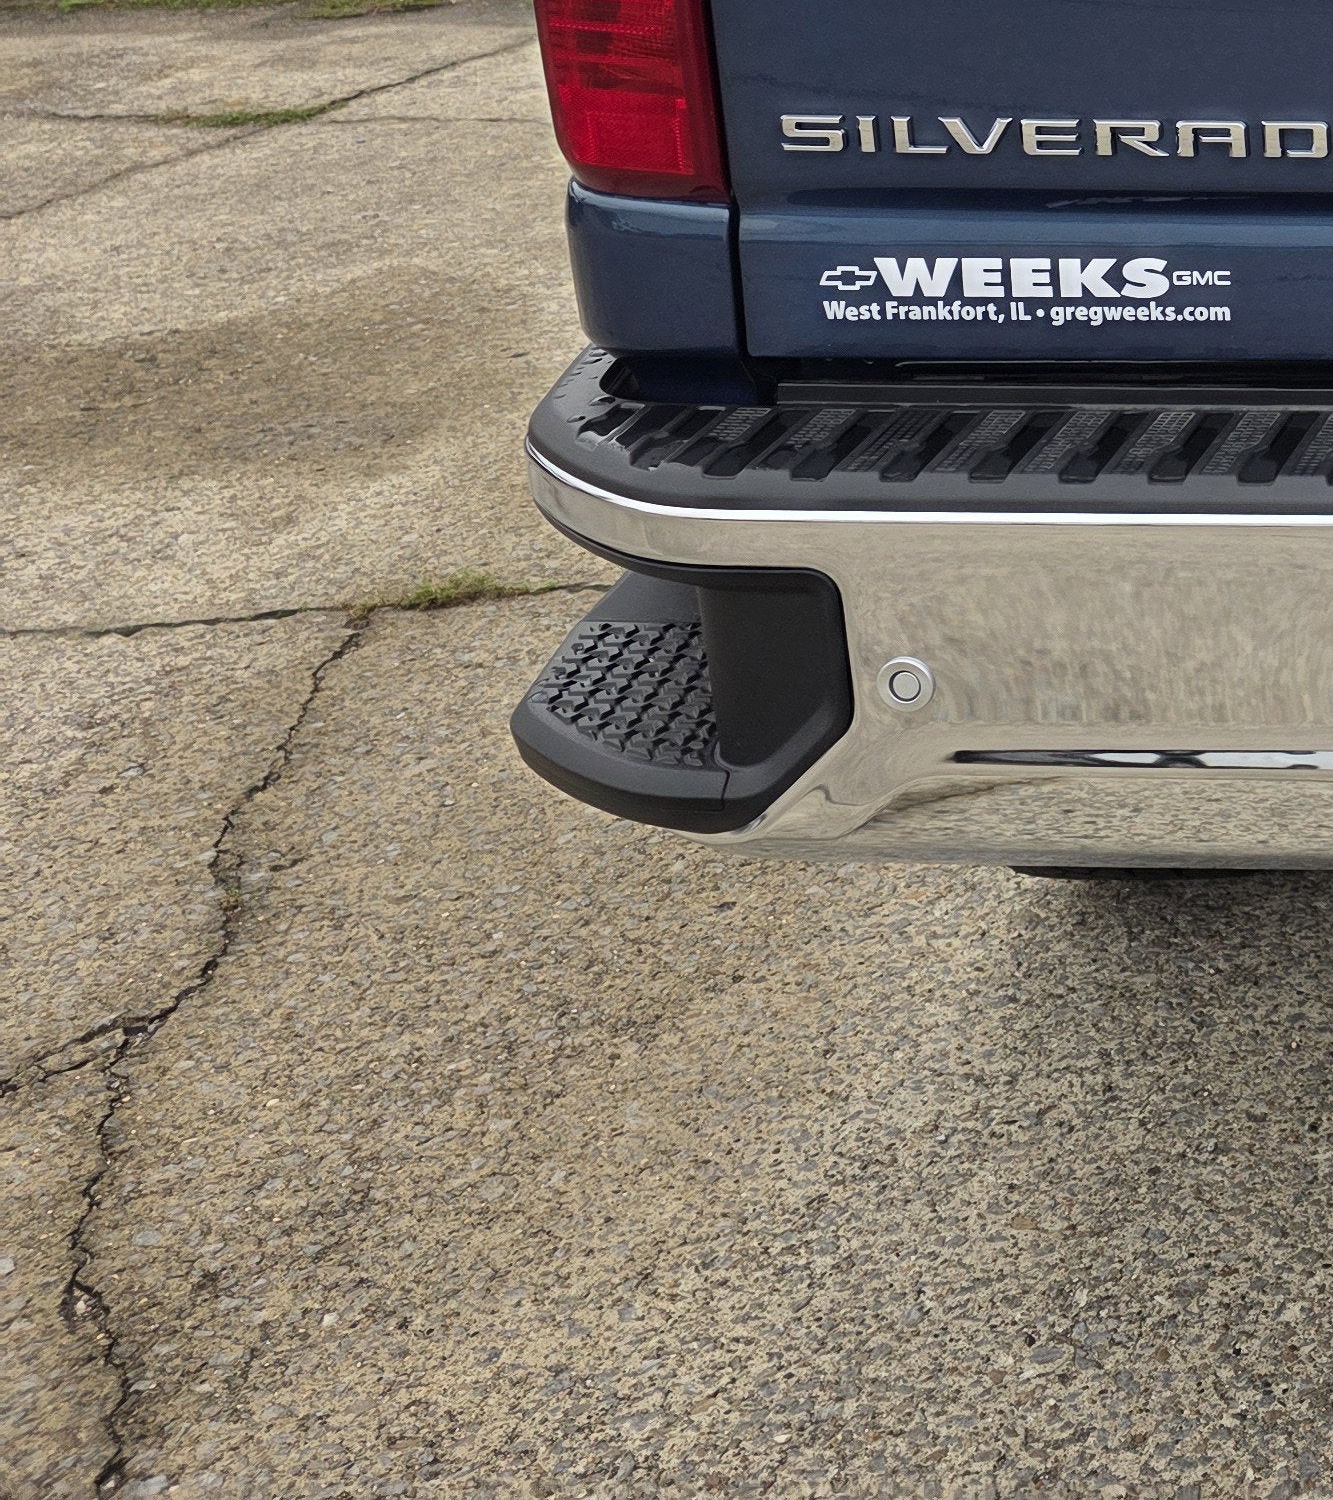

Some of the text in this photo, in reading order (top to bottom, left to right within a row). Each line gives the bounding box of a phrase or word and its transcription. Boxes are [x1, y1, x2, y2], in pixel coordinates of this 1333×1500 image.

[873, 257, 1232, 299] WEEKS GMC
[822, 300, 1232, 327] West Frankfort, IL gregweeks.com
